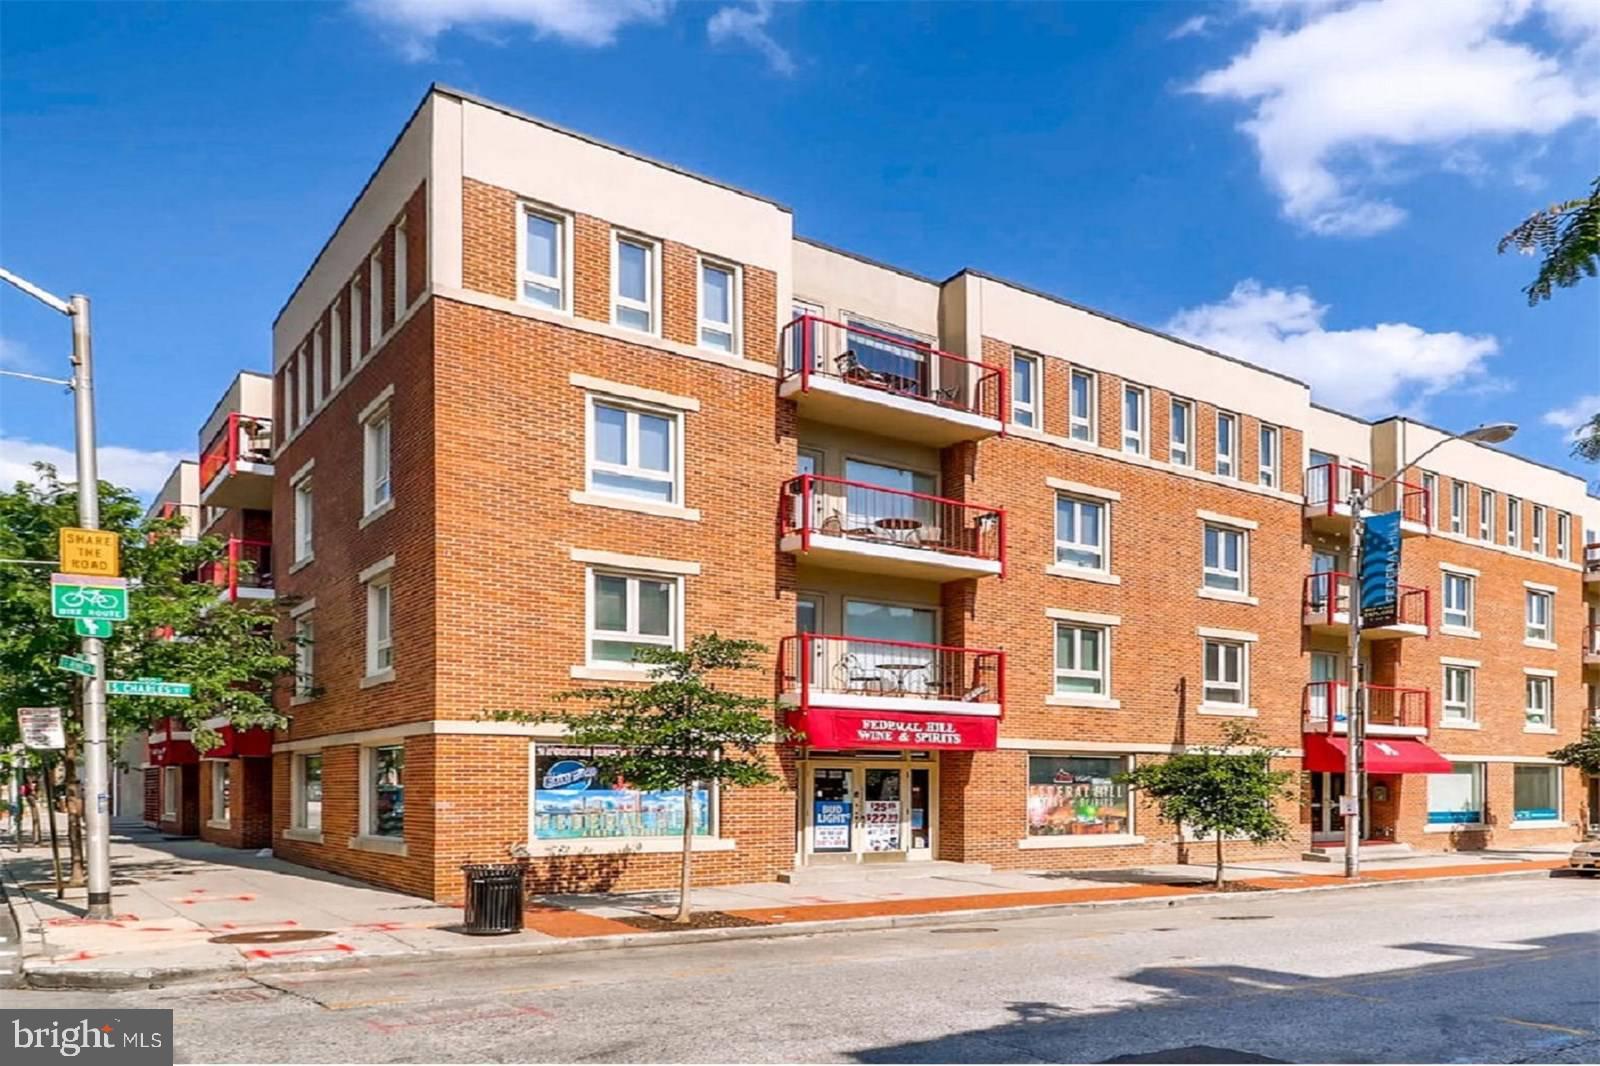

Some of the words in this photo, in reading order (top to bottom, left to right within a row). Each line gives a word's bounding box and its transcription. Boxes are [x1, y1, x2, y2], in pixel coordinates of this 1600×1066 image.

[67, 534, 112, 546] SHARE
[78, 548, 101, 558] THE
[72, 560, 107, 570] ROAD
[124, 683, 170, 694] CHARLES
[862, 719, 922, 732] FEDERAL
[926, 721, 957, 733] HILL
[857, 730, 893, 741] WINE
[898, 732, 909, 742] &
[914, 733, 962, 744] SPIRITS
[822, 805, 843, 814] BUD
[817, 814, 851, 824] LIGHT
